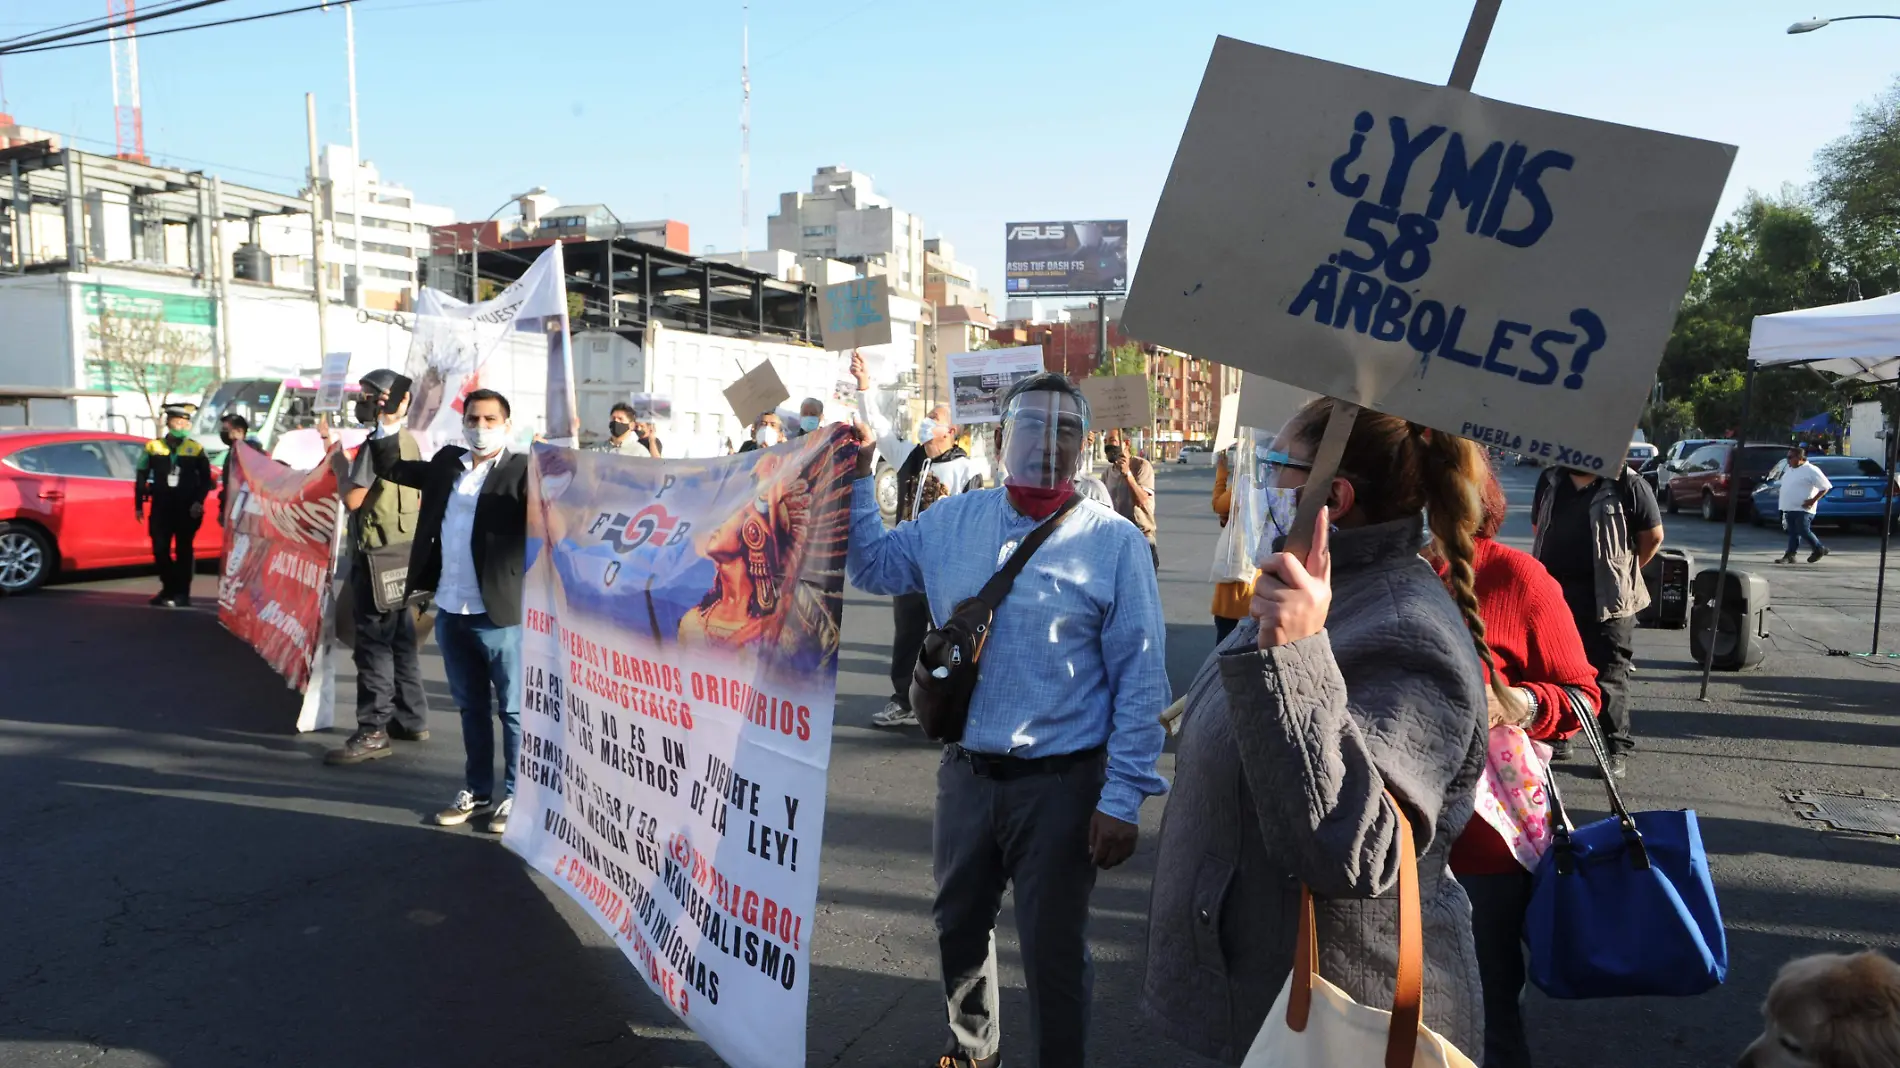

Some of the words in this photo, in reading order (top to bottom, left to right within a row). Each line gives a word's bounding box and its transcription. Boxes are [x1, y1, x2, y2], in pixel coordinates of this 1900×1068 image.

[1007, 261, 1028, 271] ASUS
[1030, 260, 1045, 270] TUF
[1048, 260, 1069, 270] DASH
[1071, 261, 1084, 270] F15
[1008, 225, 1064, 240] ASUS
[1336, 200, 1438, 283] 58
[1287, 252, 1607, 390] ÁRBOLES?
[655, 474, 676, 498] P
[1461, 422, 1522, 449] PUEBLO
[1529, 439, 1552, 456] DE
[1554, 444, 1603, 470] XOCO
[588, 512, 611, 534] F
[666, 522, 691, 546] B
[526, 608, 556, 637] FRENT
[601, 646, 608, 672] Y
[612, 650, 683, 696] BARRIOS
[525, 688, 560, 723] MENOS
[579, 723, 594, 755] LOS
[601, 738, 679, 797] MAESTROS
[690, 780, 708, 816] DE
[711, 798, 728, 837] LA
[747, 819, 798, 872] LEY!
[601, 710, 617, 740] NO
[630, 723, 645, 754] ES
[662, 736, 687, 770] UN
[705, 753, 760, 817] JUGUETE
[785, 795, 799, 831] Y
[587, 802, 629, 855] MEDIDA
[635, 839, 661, 877] DEL
[664, 857, 796, 991] NEOLIBERALISMO
[626, 803, 635, 830] Y
[709, 865, 802, 951] PELIGRO!
[601, 855, 655, 926] DERECHOS
[650, 908, 719, 1005] INDÍGENAS
